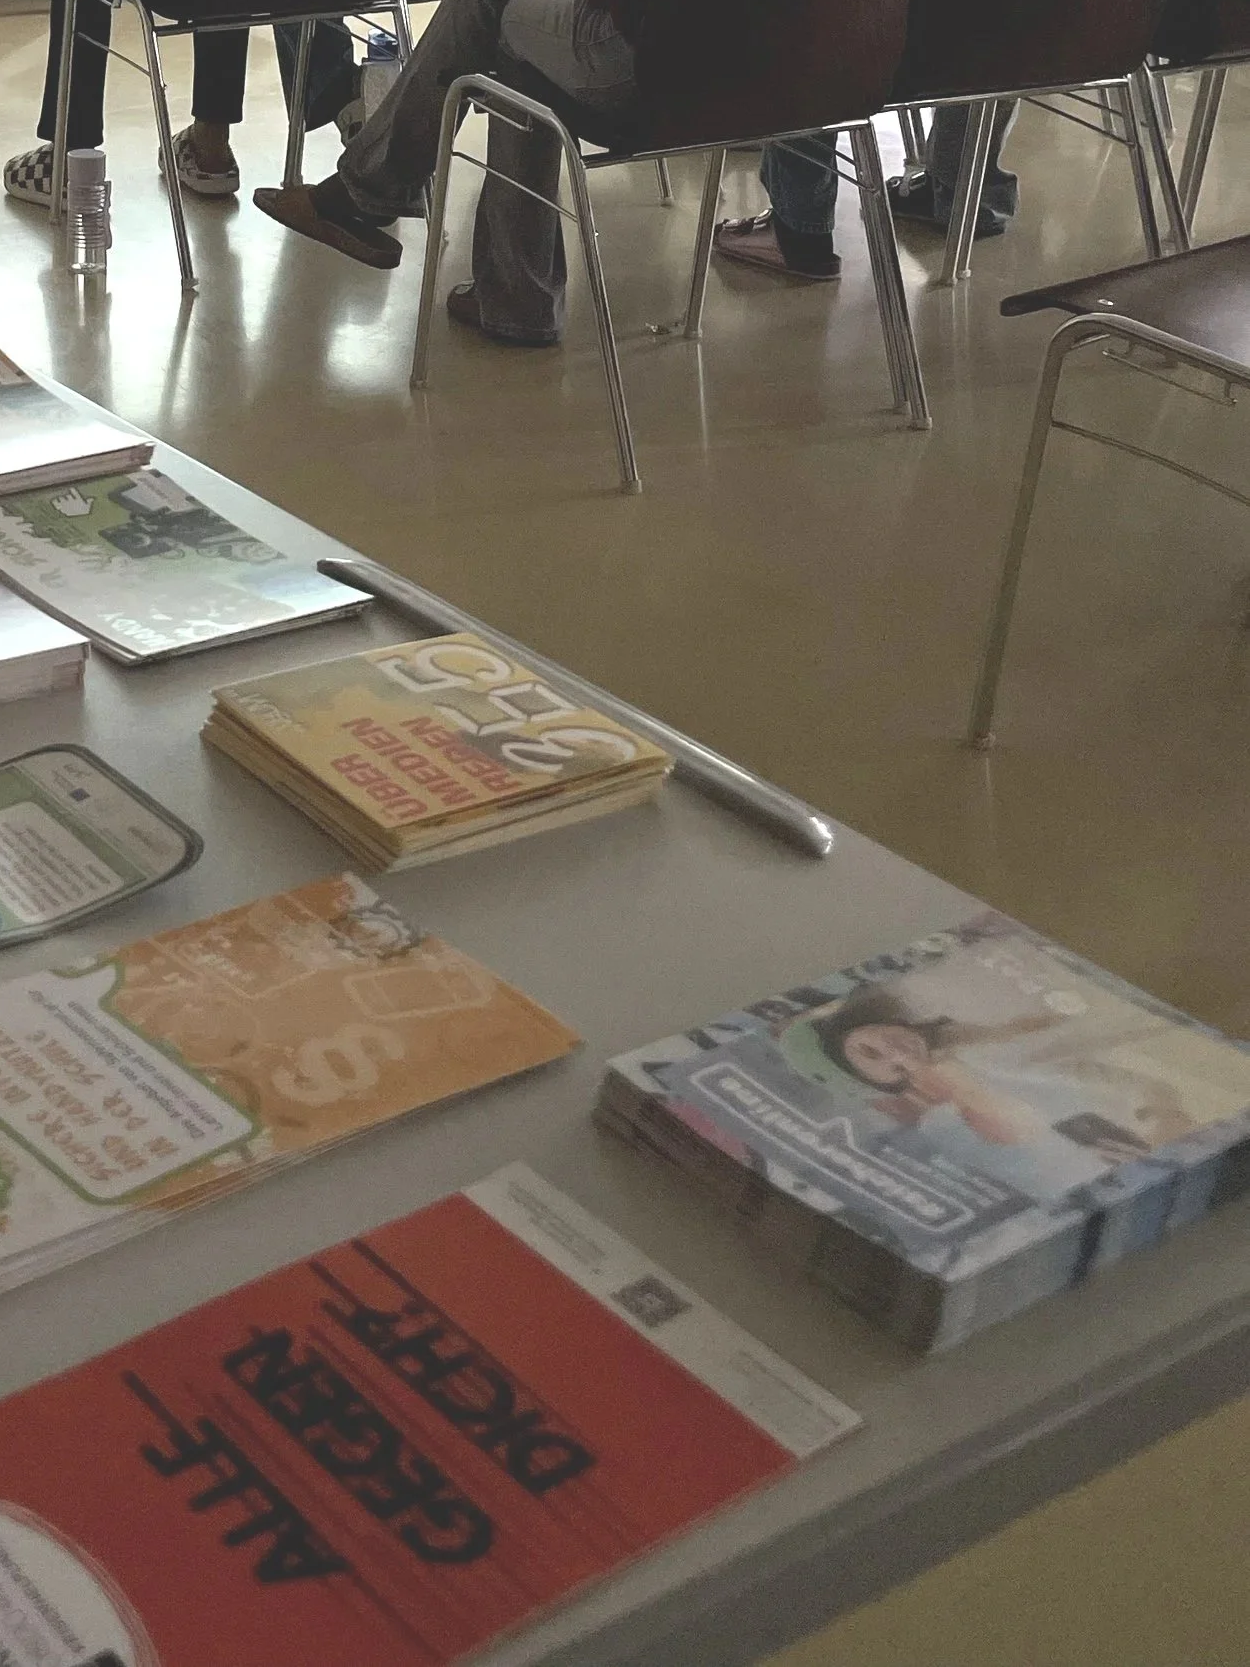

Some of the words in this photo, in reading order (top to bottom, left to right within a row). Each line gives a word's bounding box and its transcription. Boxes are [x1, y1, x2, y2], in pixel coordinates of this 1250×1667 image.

[341, 716, 479, 807] MEDIEN
[377, 642, 637, 774] 365
[399, 716, 524, 792] REDEN
[332, 752, 429, 819] ÜBER
[222, 1326, 495, 1564] GEGEN
[338, 1299, 600, 1494] DICH?
[139, 1414, 355, 1586] ALLE
